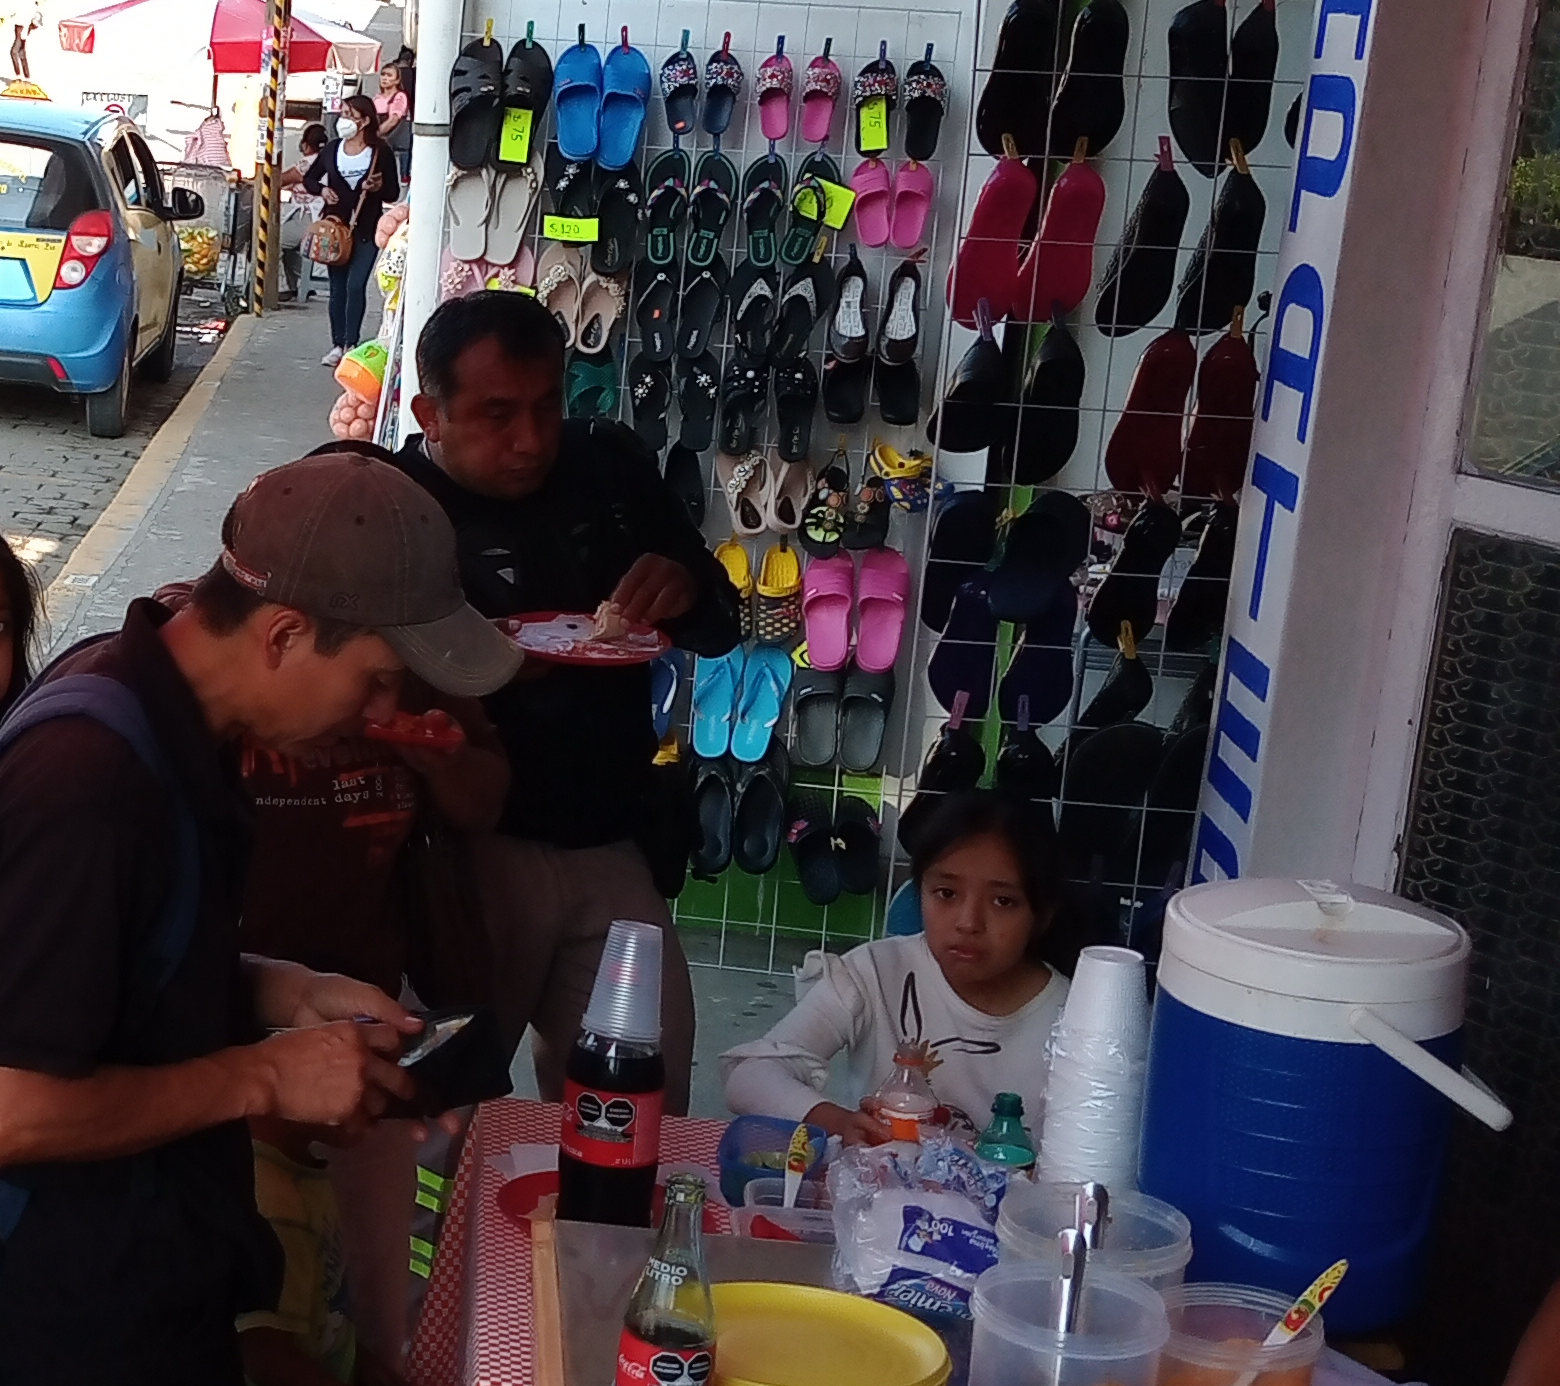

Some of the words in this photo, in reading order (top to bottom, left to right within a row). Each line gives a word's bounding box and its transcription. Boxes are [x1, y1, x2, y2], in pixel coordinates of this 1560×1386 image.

[332, 775, 367, 792] last
[333, 790, 370, 805] days
[930, 1219, 955, 1238] 100
[645, 1265, 684, 1286] LITRO
[647, 1256, 689, 1278] MEDIO
[924, 1280, 958, 1301] Nova
[888, 1283, 973, 1321] Pemier
